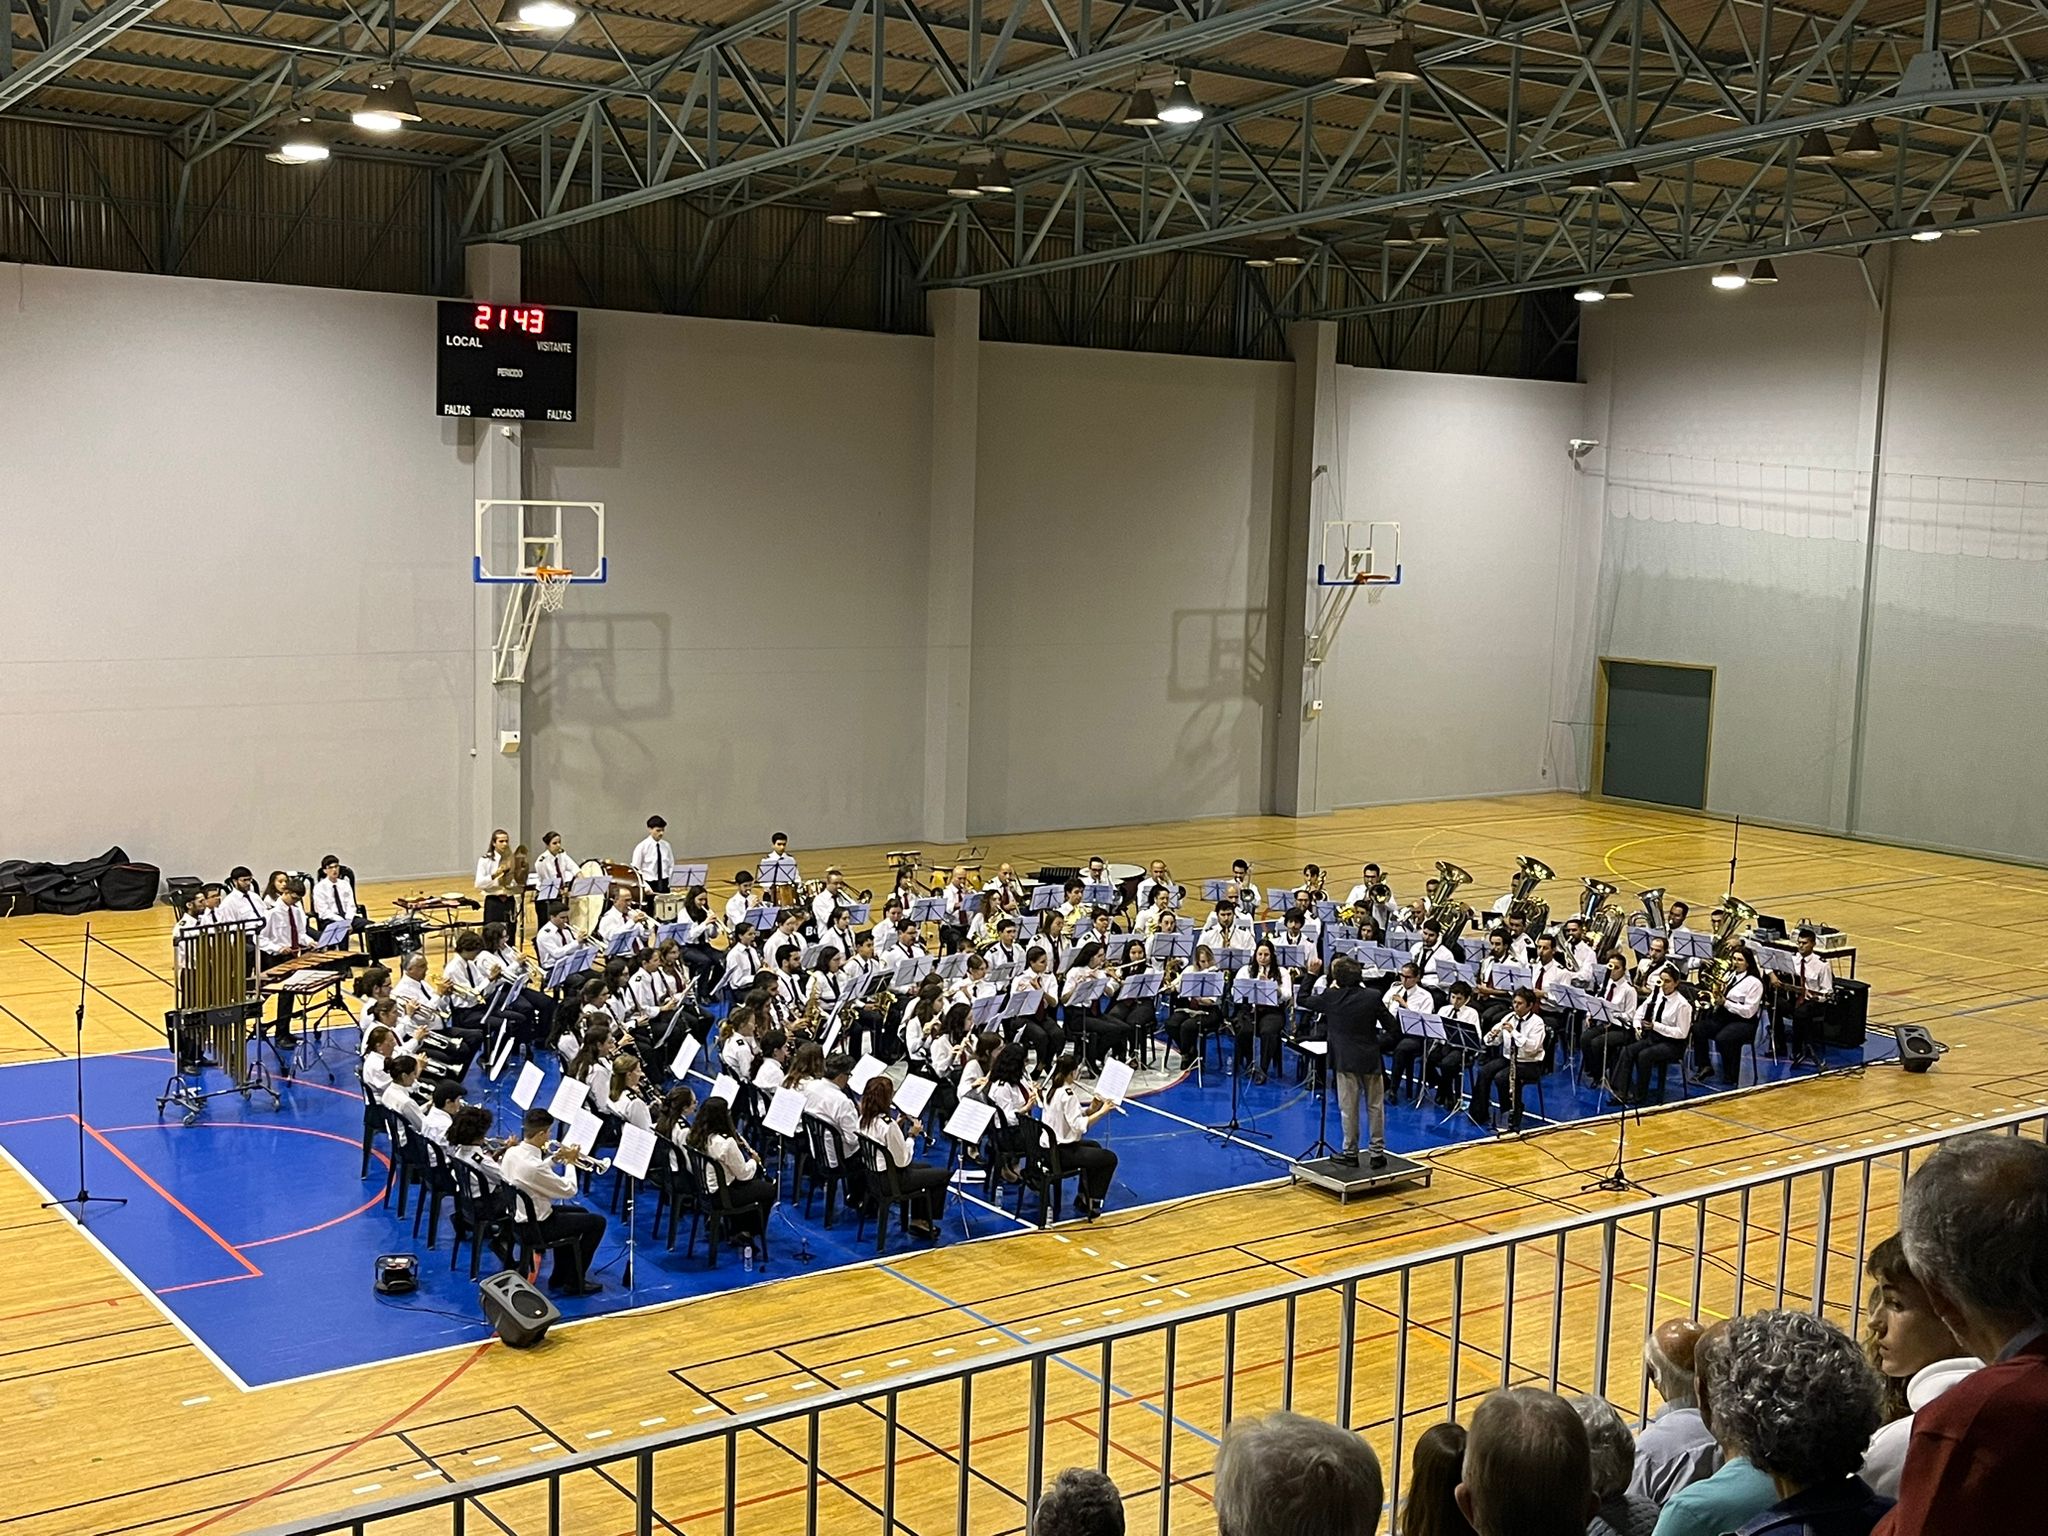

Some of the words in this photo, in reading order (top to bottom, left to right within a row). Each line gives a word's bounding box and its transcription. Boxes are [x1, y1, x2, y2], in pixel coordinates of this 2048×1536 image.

[446, 335, 483, 348] LOCAL
[536, 341, 572, 353] VISITANTE
[444, 404, 471, 416] FALTAS
[491, 408, 525, 418] JOGADOR
[547, 409, 572, 420] FALTAS
